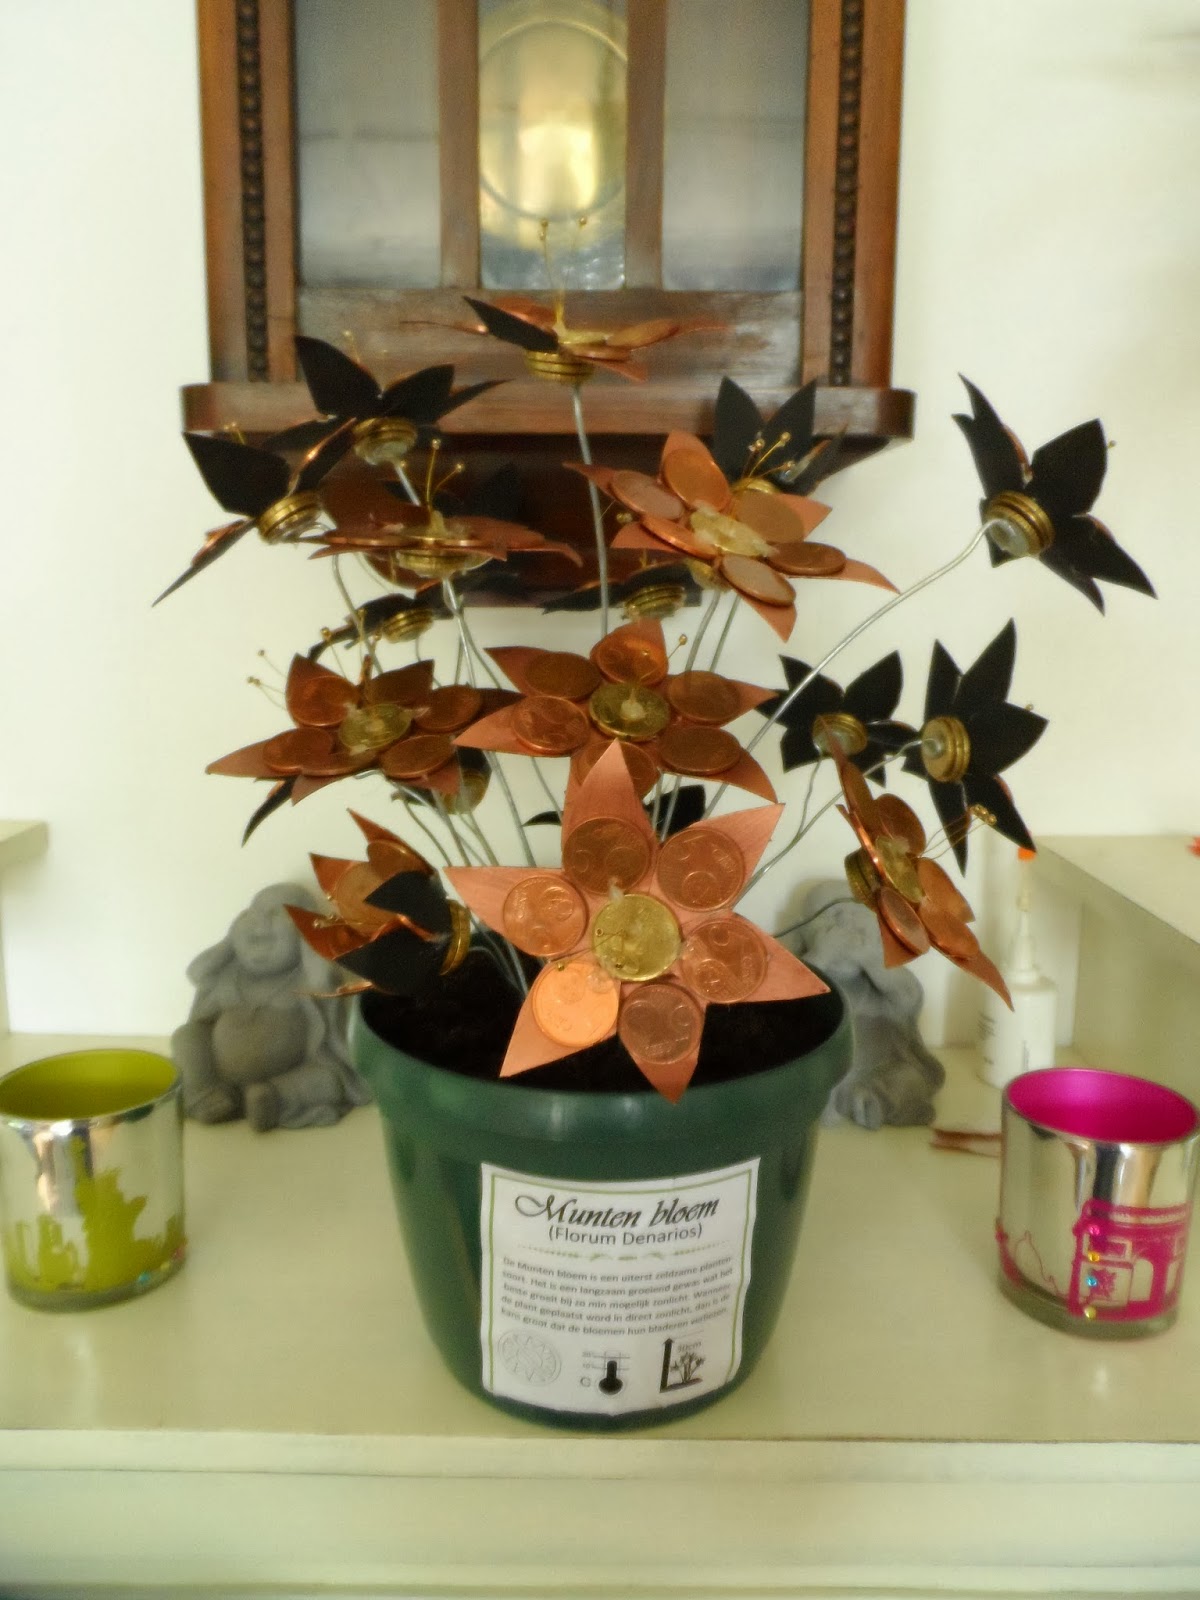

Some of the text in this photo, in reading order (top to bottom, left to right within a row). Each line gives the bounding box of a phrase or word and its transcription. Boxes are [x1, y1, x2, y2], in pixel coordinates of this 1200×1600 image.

[515, 1194, 720, 1228] Munten bloem
[548, 1223, 703, 1246] (Florum Denarios)
[557, 1270, 588, 1281] bloem
[590, 1274, 597, 1282] is
[622, 1274, 652, 1282] uiterst
[656, 1267, 698, 1279] zeldzame
